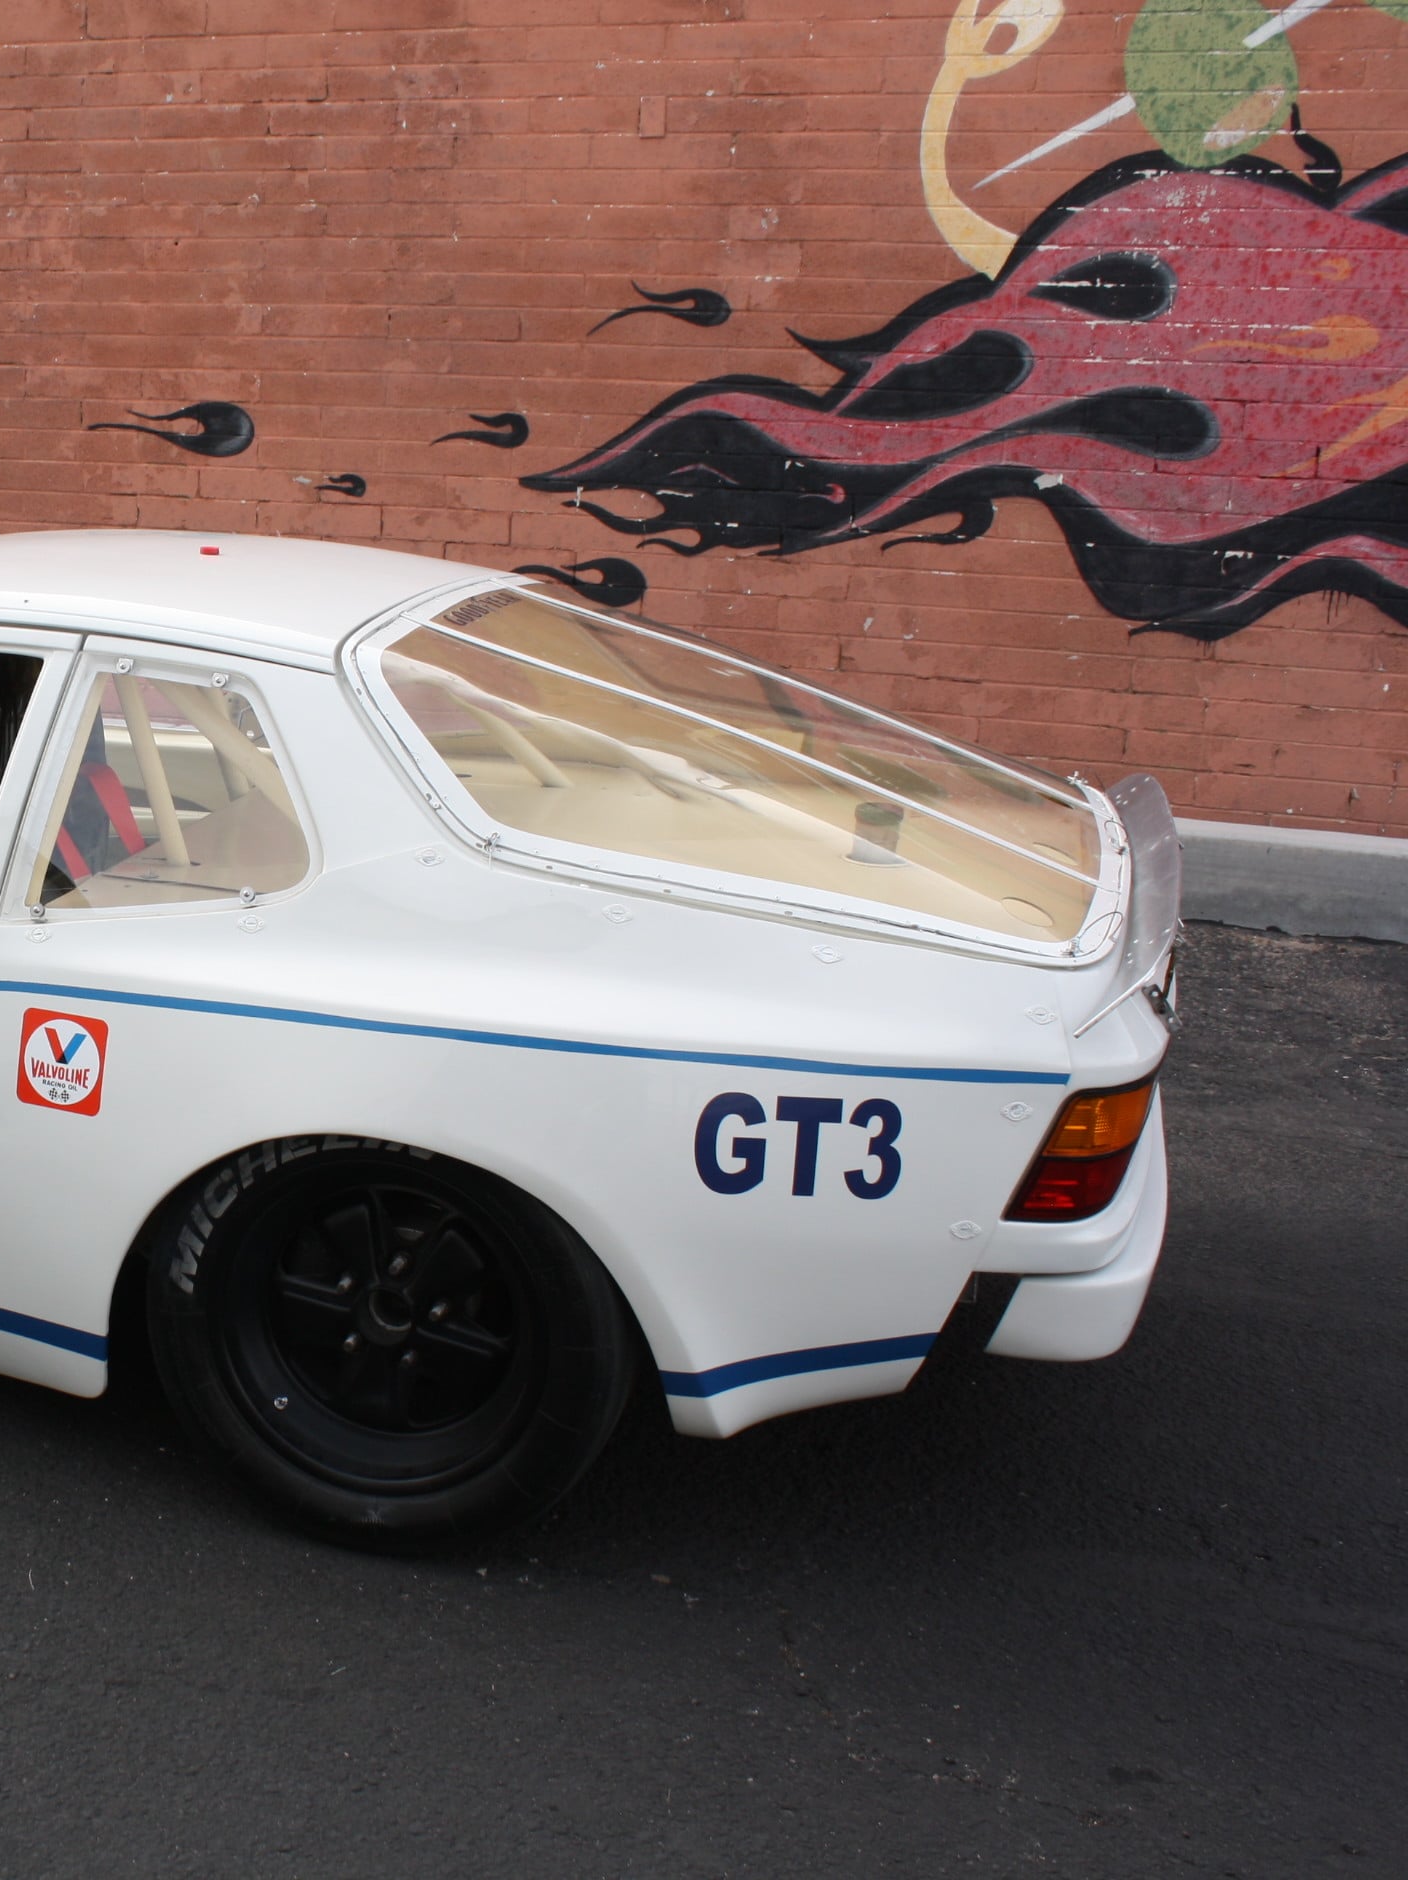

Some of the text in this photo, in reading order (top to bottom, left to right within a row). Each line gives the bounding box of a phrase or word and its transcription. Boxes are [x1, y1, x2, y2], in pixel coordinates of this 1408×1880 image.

[30, 1057, 90, 1090] VALVOLINE
[42, 1079, 66, 1089] RACING
[694, 1091, 904, 1200] GT3
